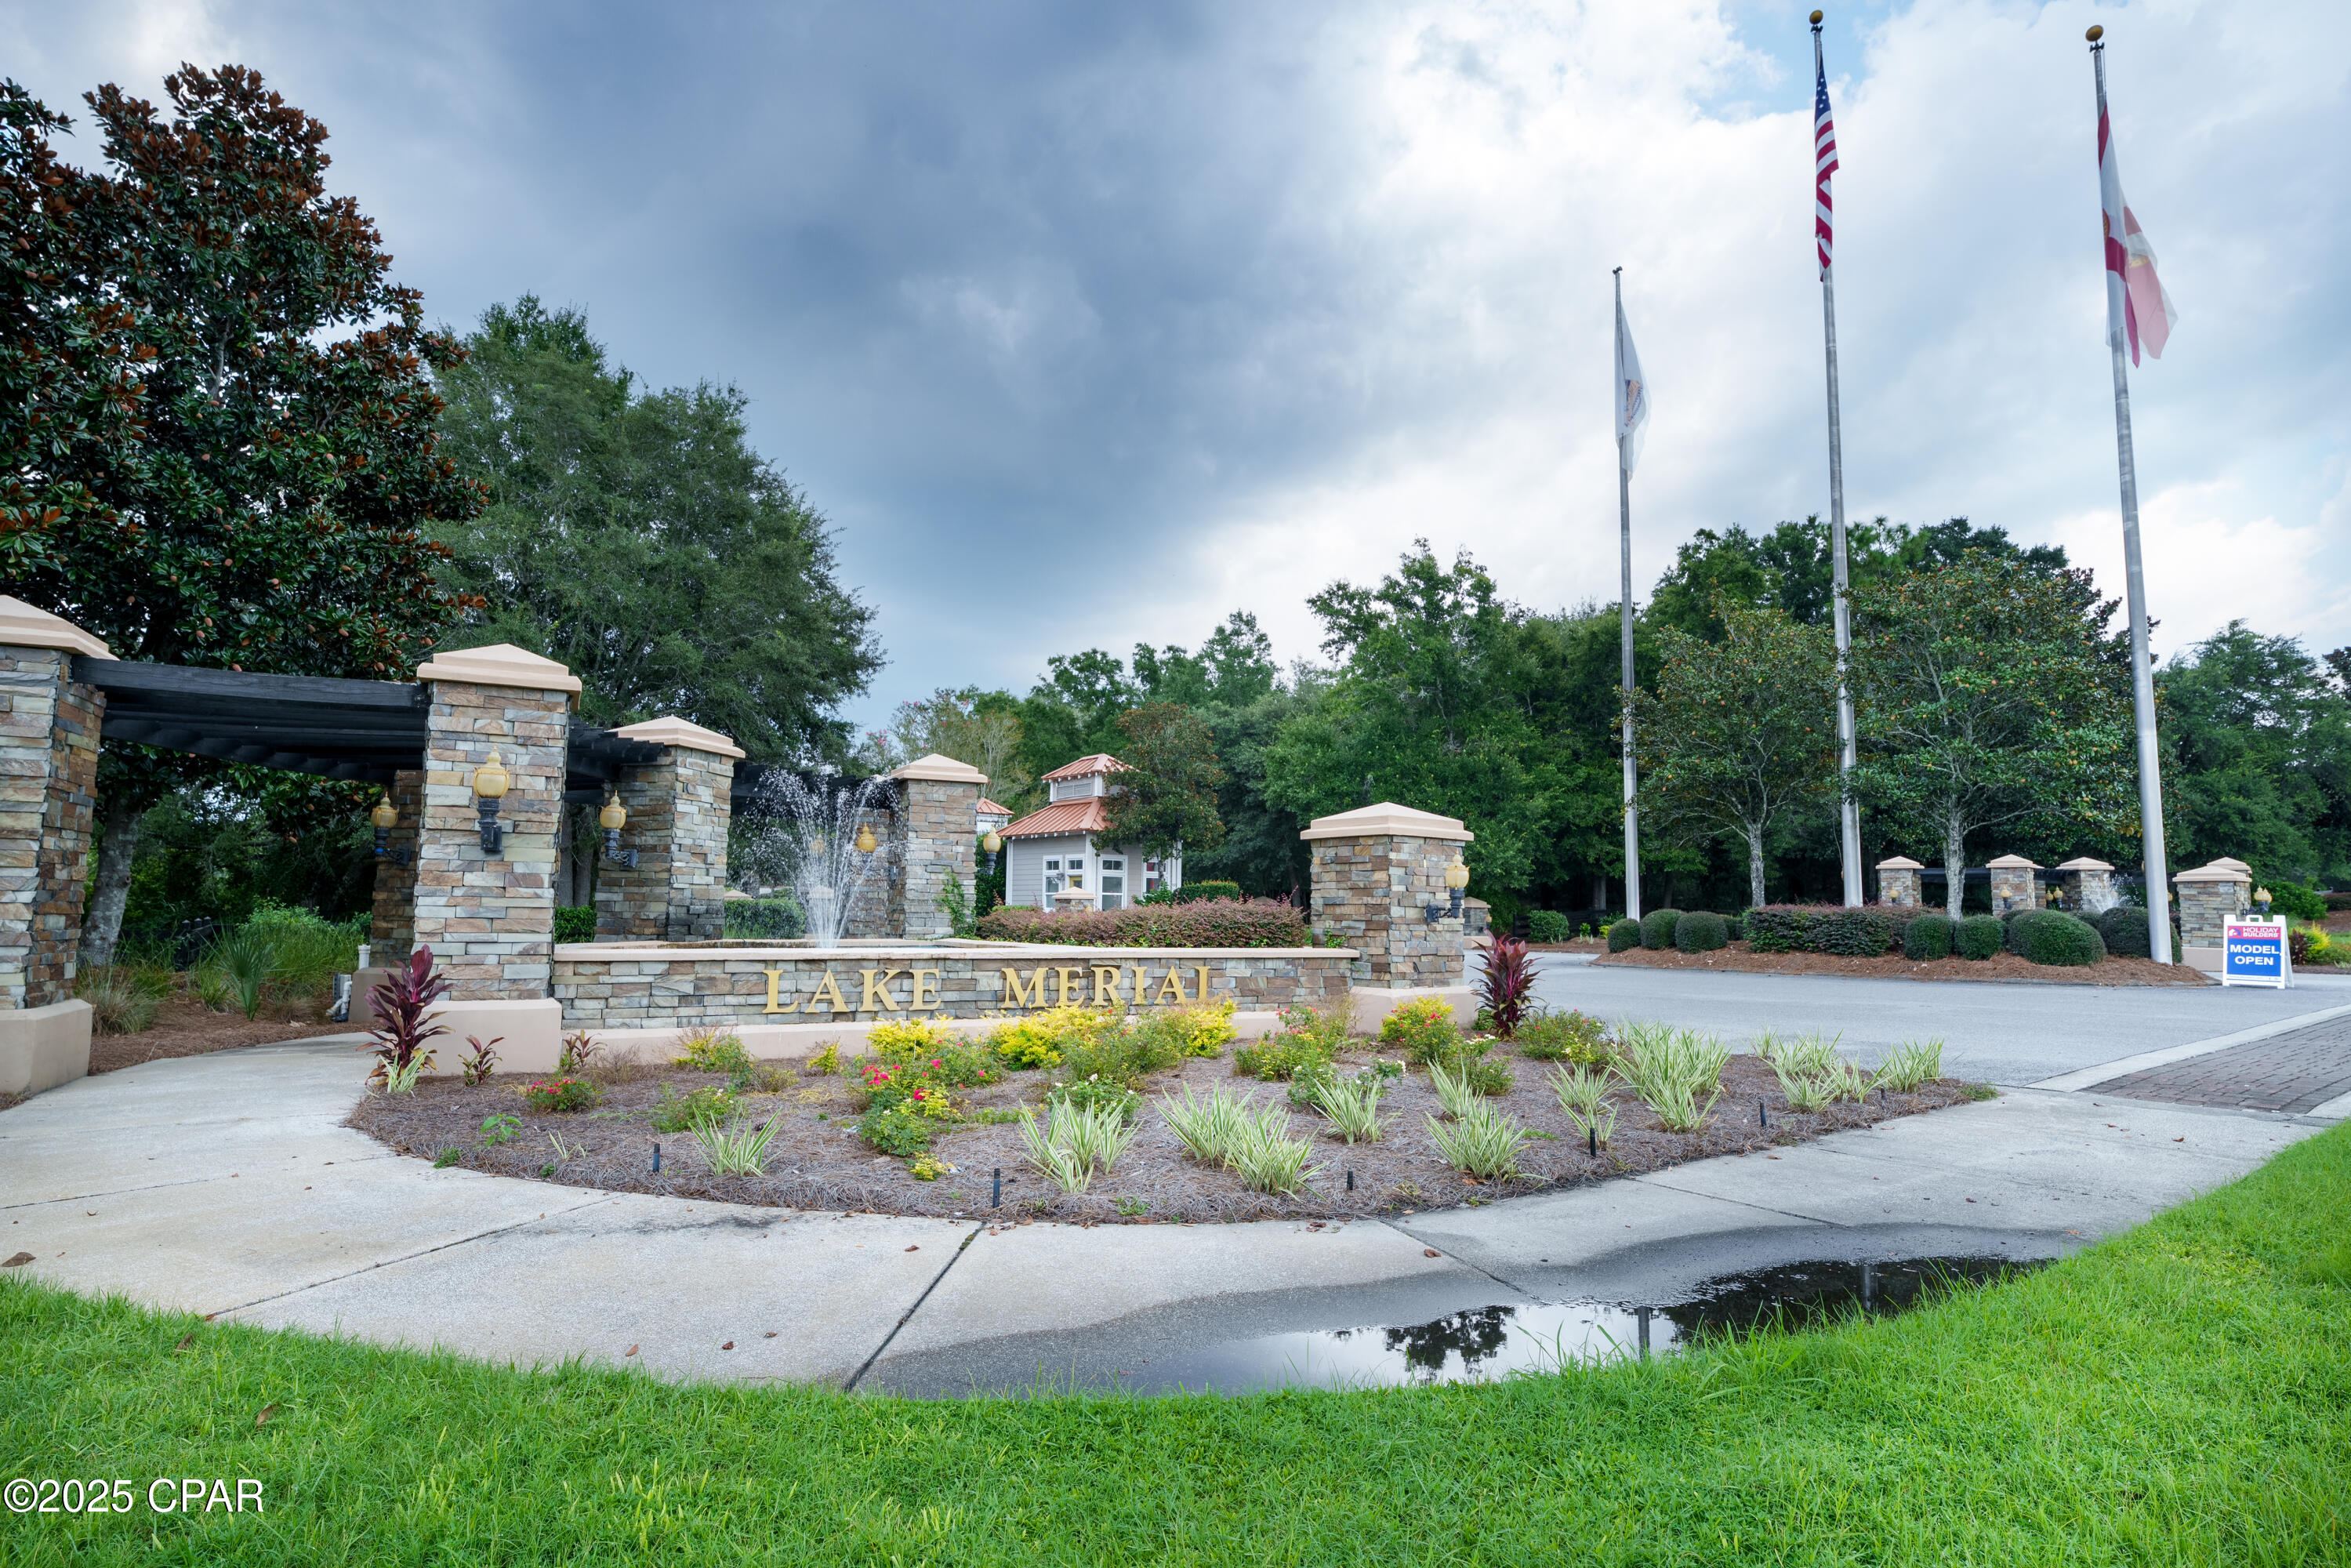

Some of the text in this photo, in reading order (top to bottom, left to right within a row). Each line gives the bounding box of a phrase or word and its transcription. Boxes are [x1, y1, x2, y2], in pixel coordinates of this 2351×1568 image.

[2229, 944, 2280, 954] MODEL
[2234, 956, 2274, 965] OPEN
[763, 965, 1223, 1014] LAKE MERIAL
